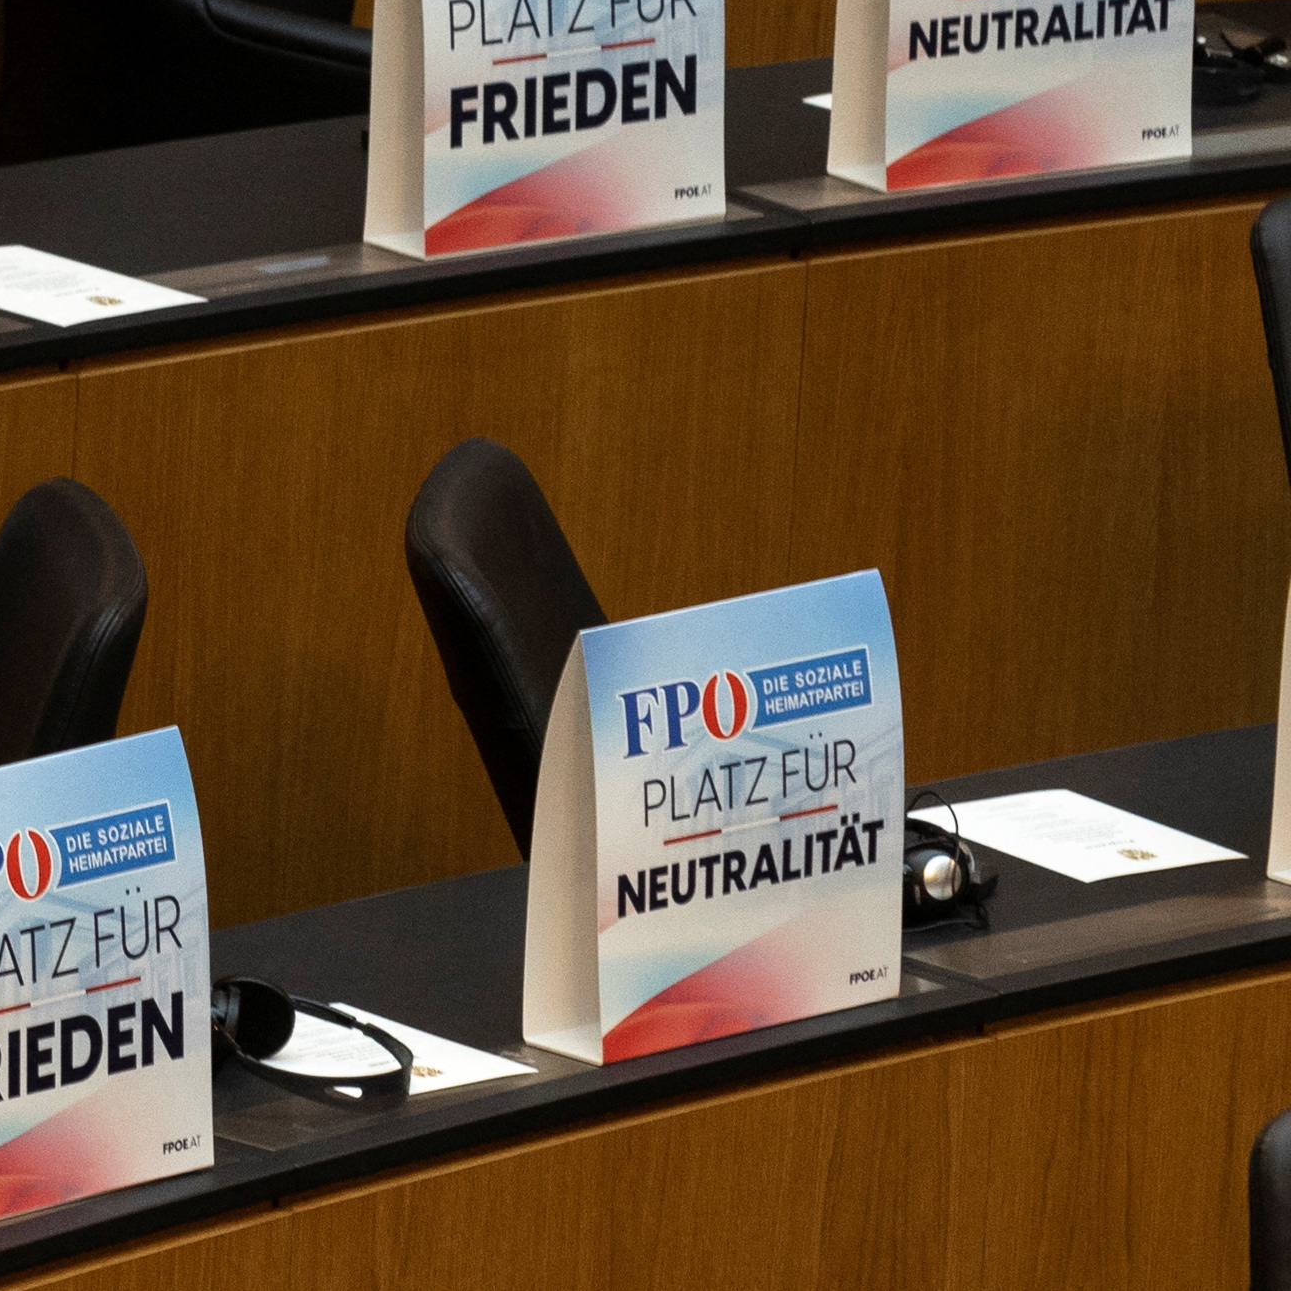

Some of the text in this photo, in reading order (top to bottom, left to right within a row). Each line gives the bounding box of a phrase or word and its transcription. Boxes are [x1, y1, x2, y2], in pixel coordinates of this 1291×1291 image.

[450, 54, 697, 149] FRIEDEN
[762, 659, 862, 696] DIE SOZIALE
[764, 680, 865, 715] HEIMATPARTEI
[643, 732, 857, 827] PLATZ FÜR
[66, 815, 165, 852] DIE SOZIALE
[69, 837, 168, 873] HEIMATPARTEI
[617, 813, 883, 918] NEUTRALITÄT
[94, 886, 182, 968] FÜR
